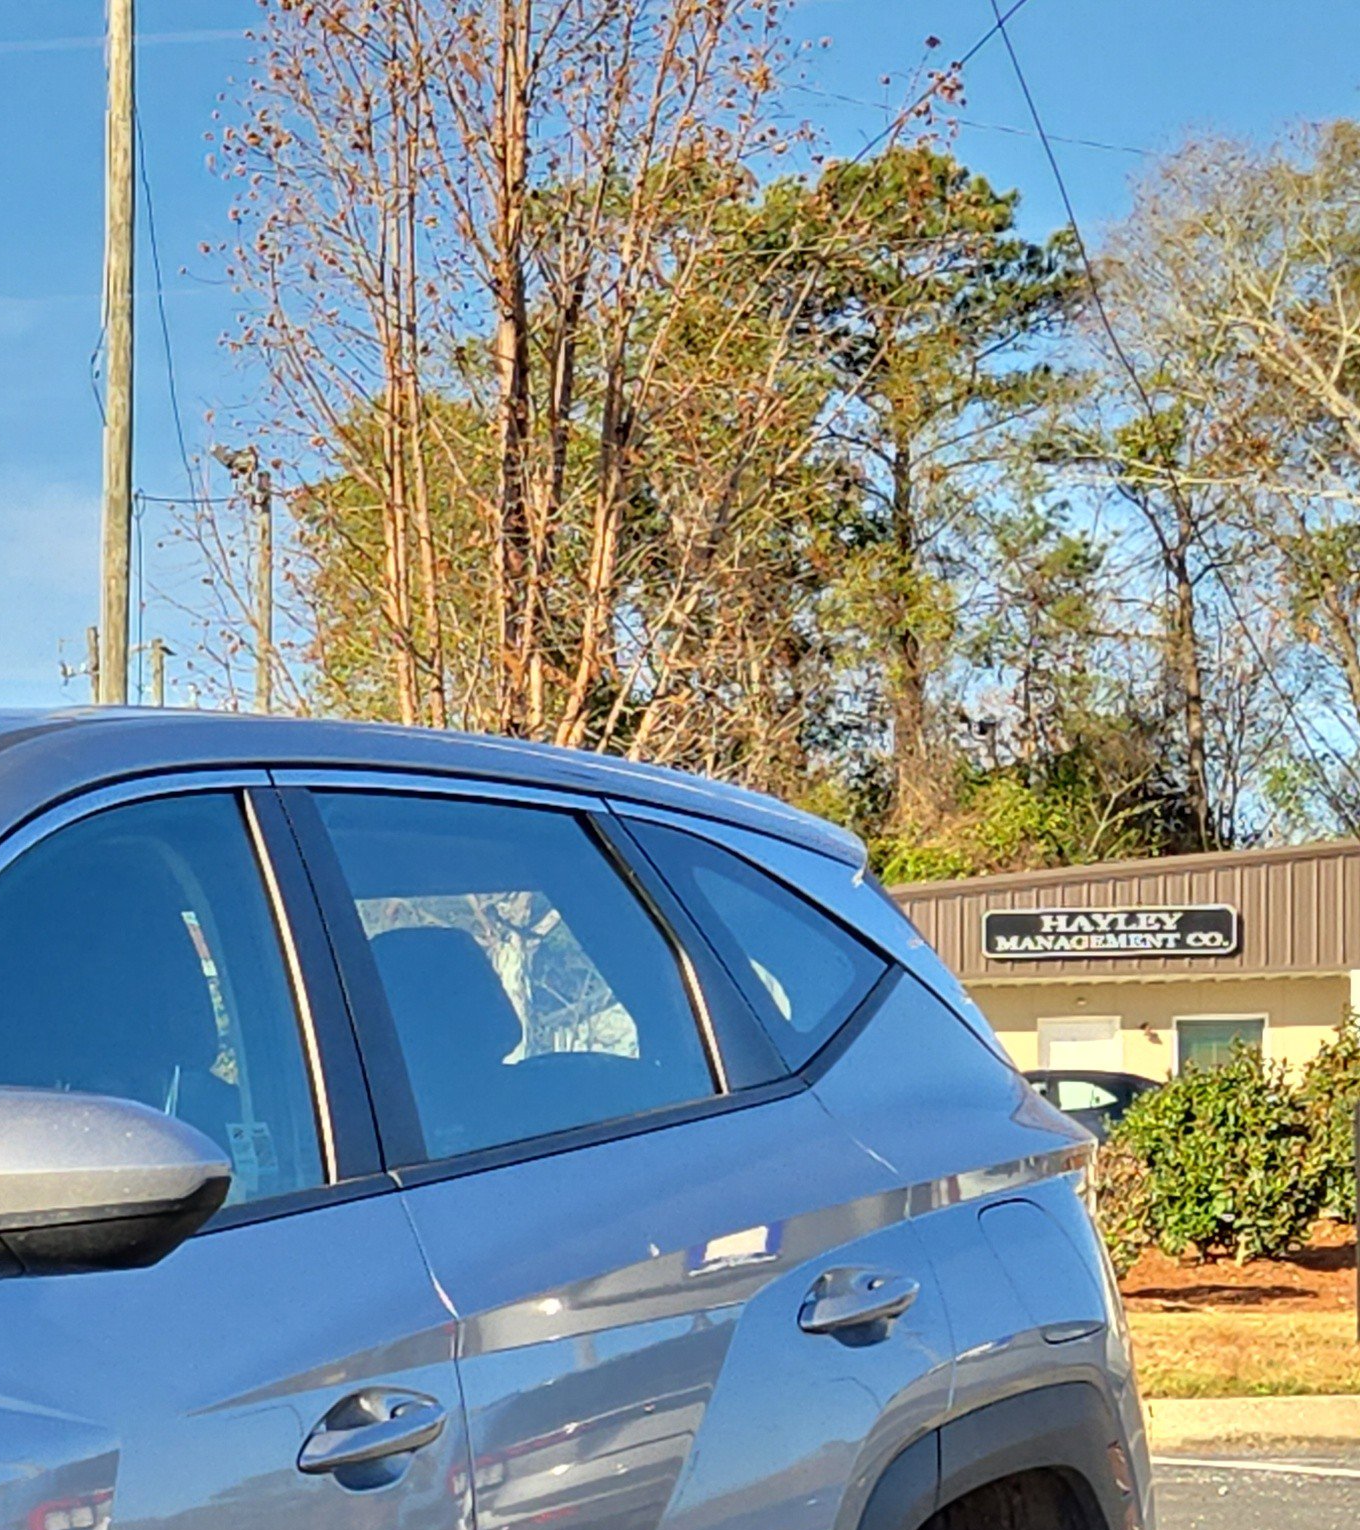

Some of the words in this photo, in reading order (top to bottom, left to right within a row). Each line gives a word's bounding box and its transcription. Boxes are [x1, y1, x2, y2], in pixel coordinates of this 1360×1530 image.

[1040, 912, 1183, 933] HAYLEY
[995, 933, 1181, 950] MANAGEMENT
[1186, 931, 1229, 947] CO.
